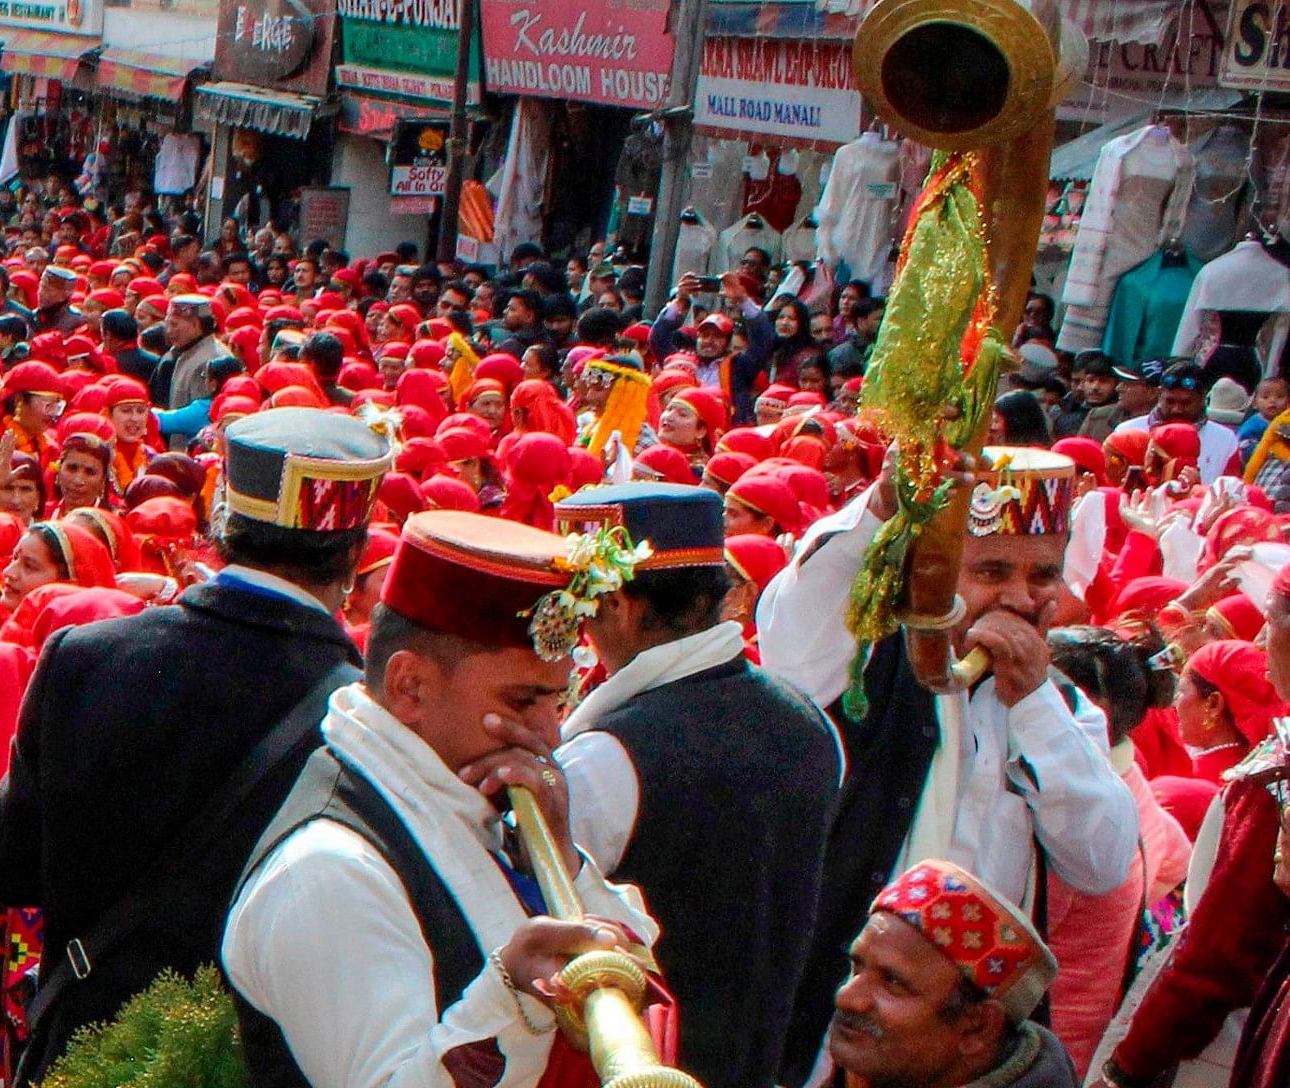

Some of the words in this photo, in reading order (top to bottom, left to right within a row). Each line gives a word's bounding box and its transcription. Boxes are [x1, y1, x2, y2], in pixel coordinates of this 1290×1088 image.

[510, 9, 638, 61] Kashmir
[486, 57, 591, 95] HANDLOOM
[707, 95, 736, 117] MALL
[739, 99, 770, 121] ROAD
[773, 103, 821, 127] MANALI
[395, 181, 411, 192] All
[409, 167, 445, 183] Softy
